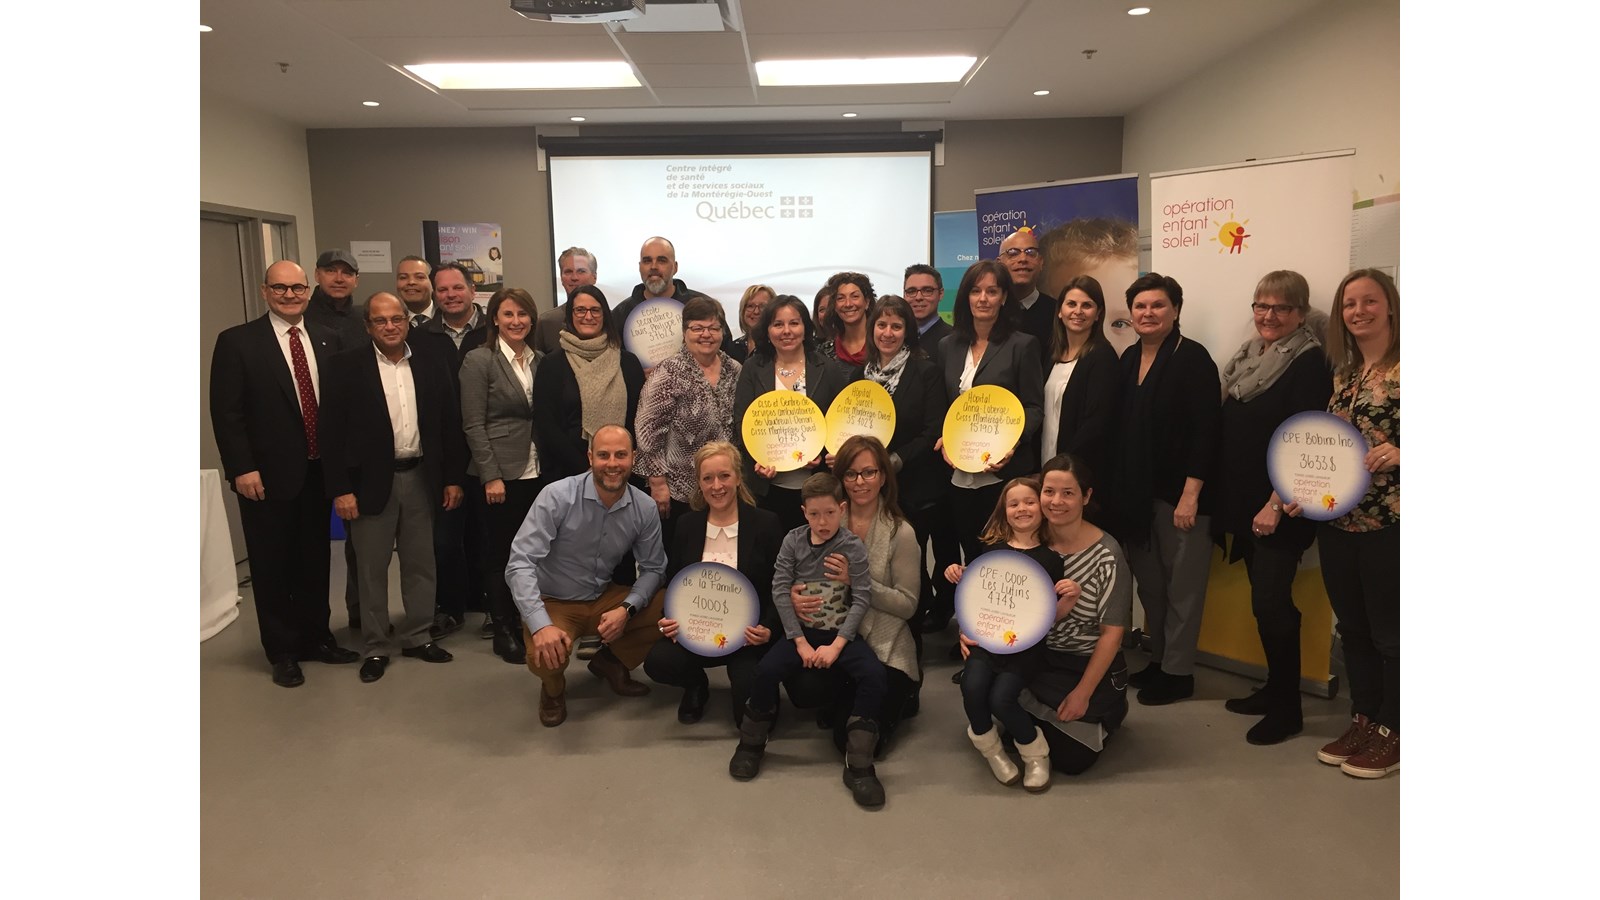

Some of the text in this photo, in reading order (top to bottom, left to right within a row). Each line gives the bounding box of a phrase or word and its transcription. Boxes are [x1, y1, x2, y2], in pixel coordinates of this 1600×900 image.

[699, 164, 732, 173] intégré
[680, 173, 705, 181] santé
[691, 191, 773, 199] Montérégie-Ouest
[696, 201, 775, 223] Québec
[1163, 198, 1234, 218] opération
[983, 210, 1026, 223] opération
[983, 222, 1010, 234] enfant
[1162, 216, 1208, 234] enfant
[1162, 233, 1199, 249] soleil
[1282, 431, 1300, 444] CPE
[682, 576, 693, 586] de
[698, 579, 707, 589] la
[688, 618, 723, 628] opération
[688, 626, 711, 635] enfant
